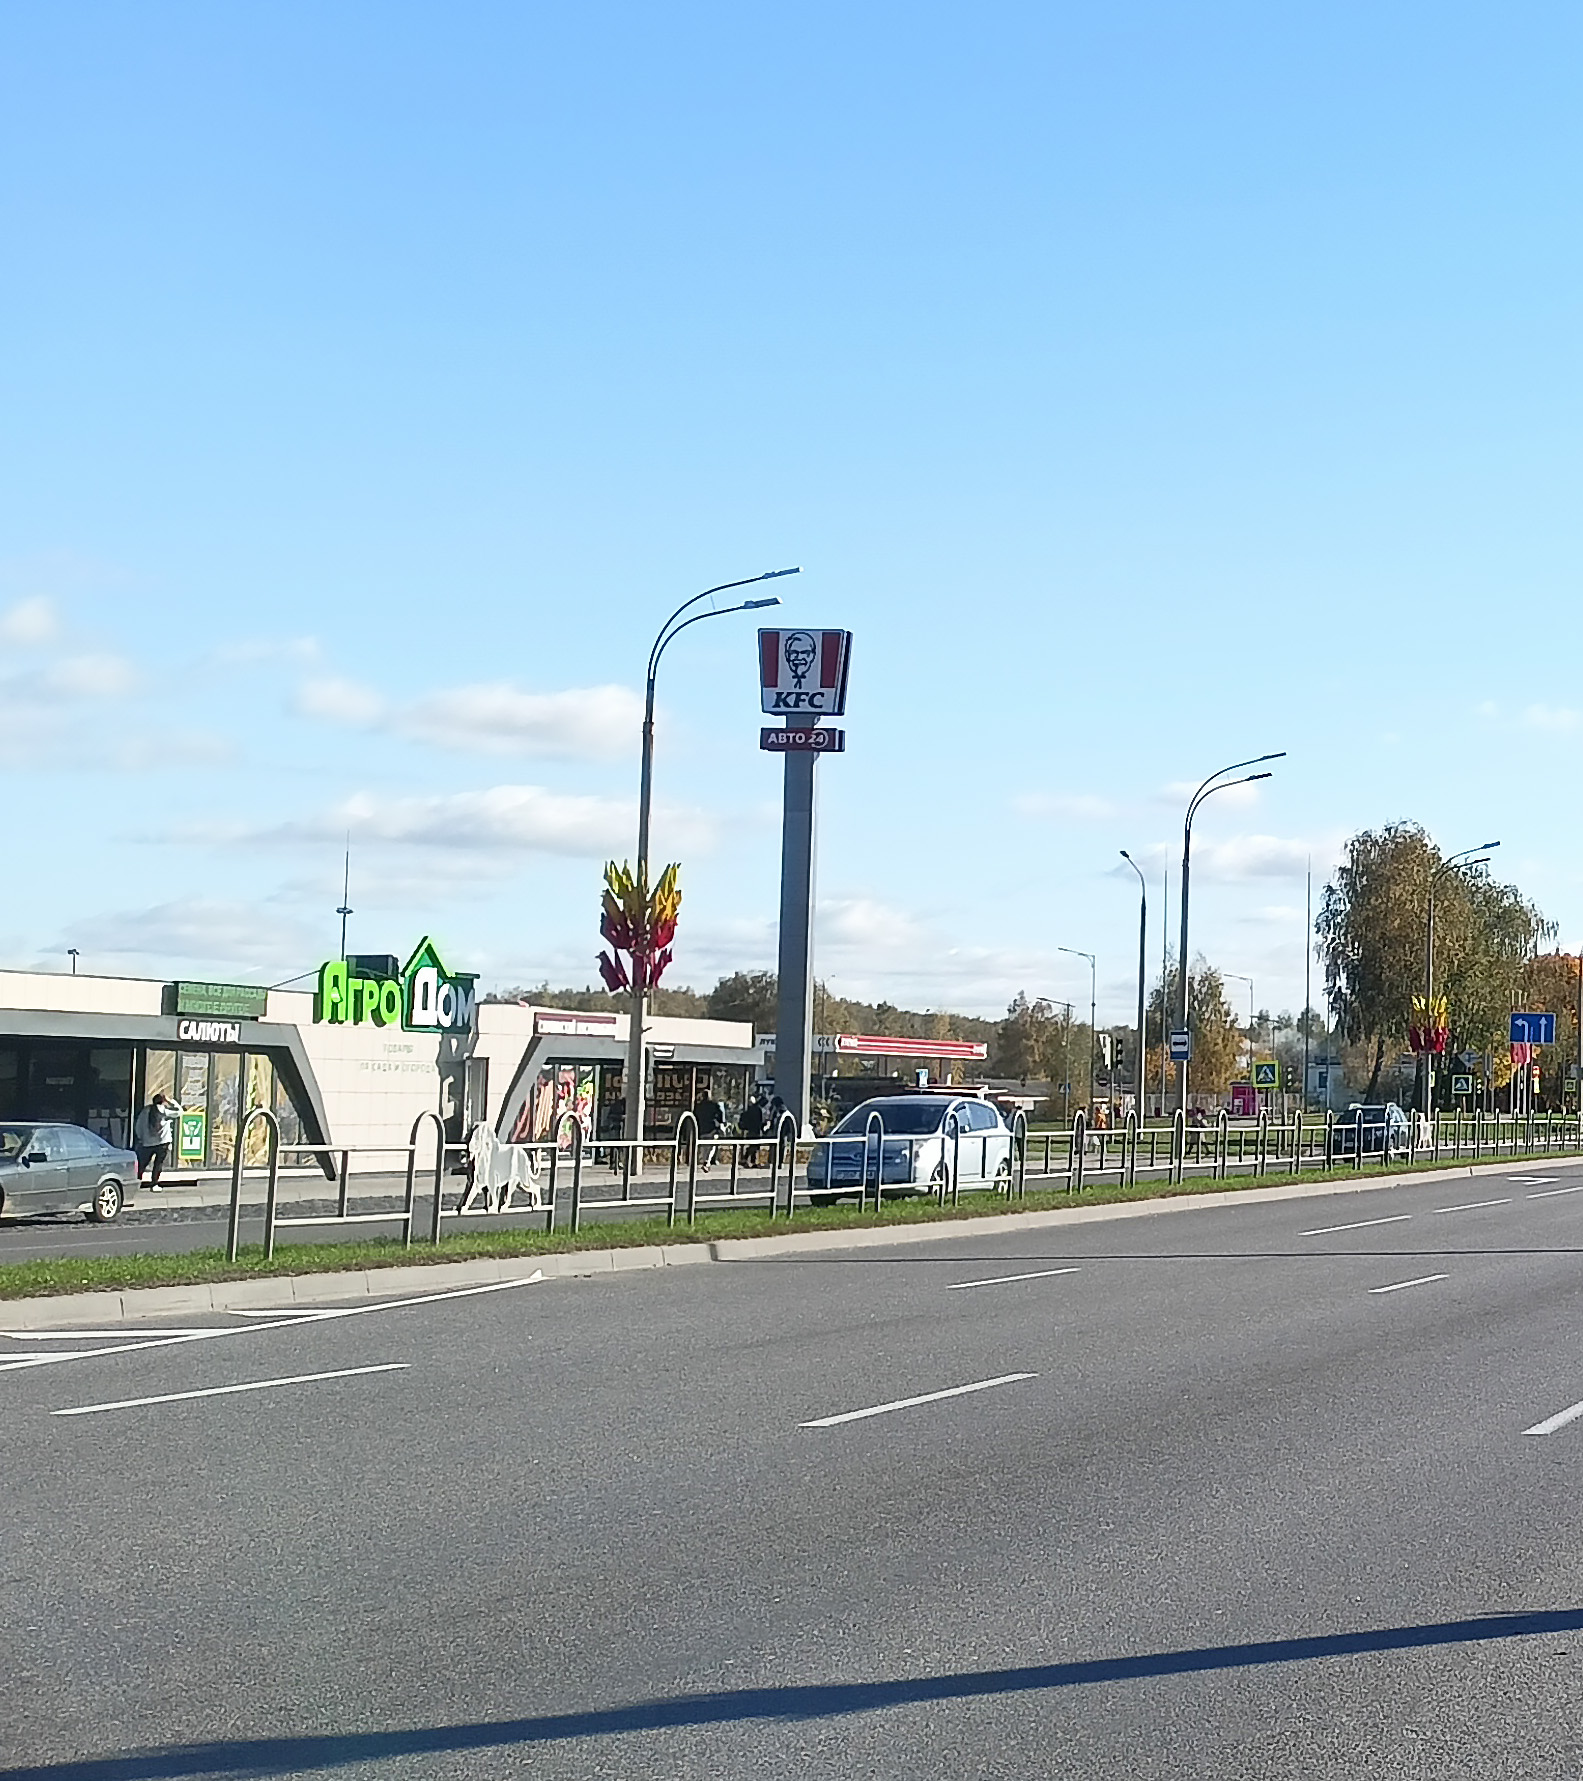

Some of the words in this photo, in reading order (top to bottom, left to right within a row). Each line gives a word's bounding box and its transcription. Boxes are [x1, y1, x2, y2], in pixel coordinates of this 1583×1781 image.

[771, 691, 825, 709] KFC
[767, 732, 806, 744] АВТО
[807, 733, 825, 744] 24
[179, 1020, 241, 1042] САЛЮТЫ
